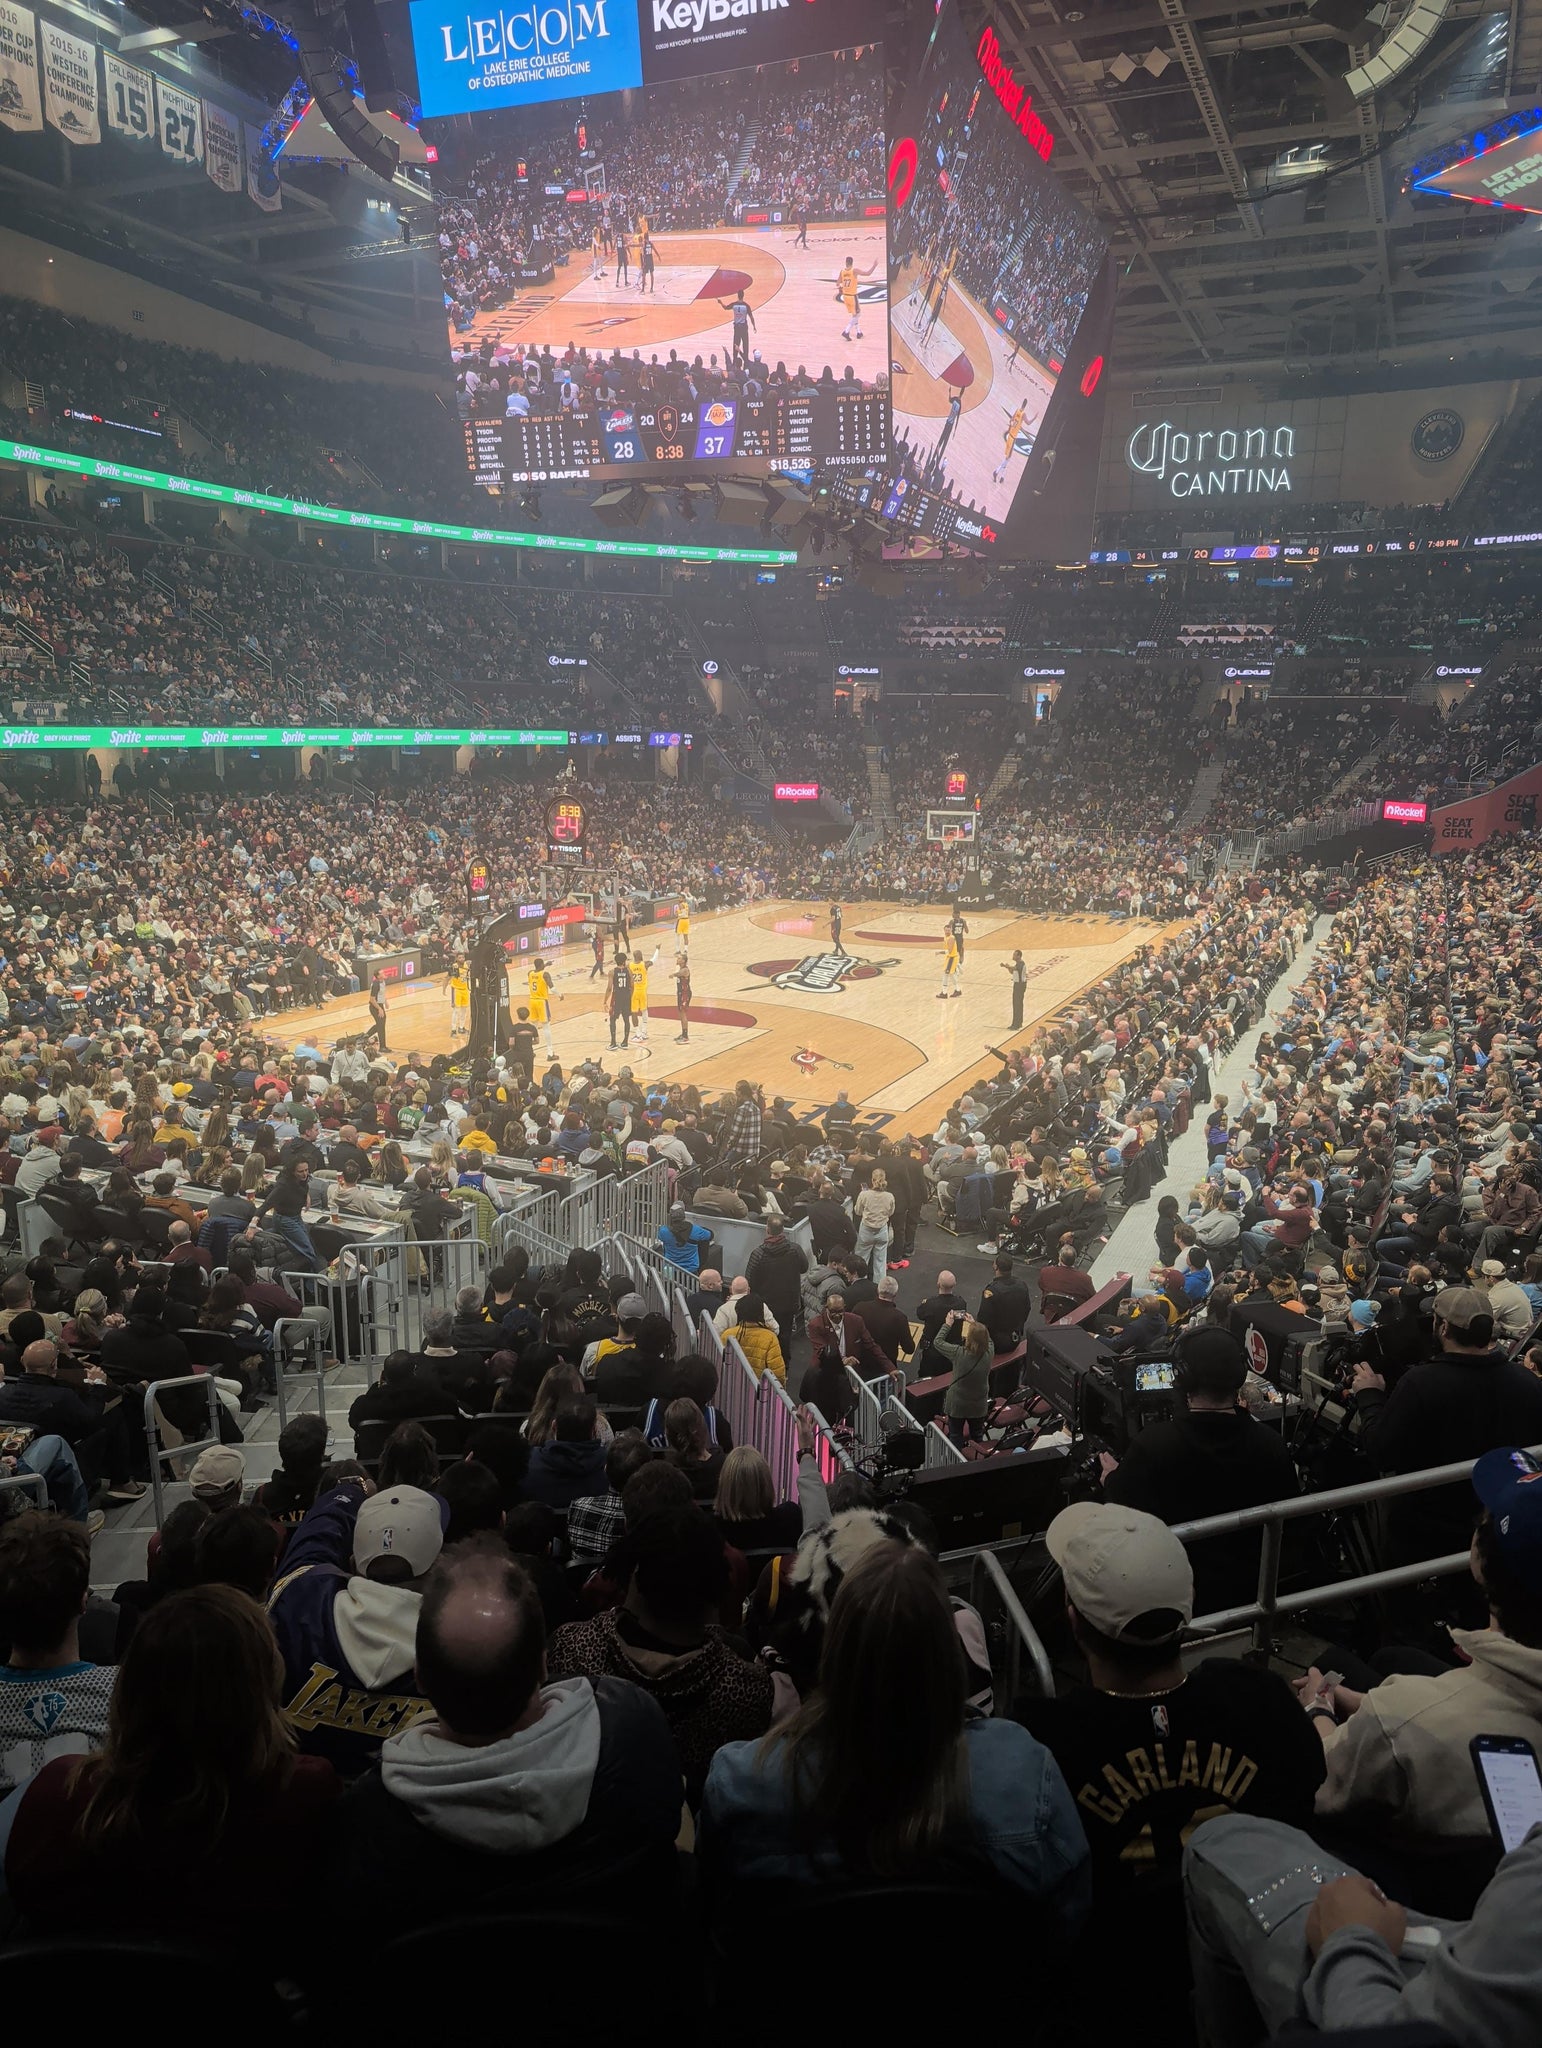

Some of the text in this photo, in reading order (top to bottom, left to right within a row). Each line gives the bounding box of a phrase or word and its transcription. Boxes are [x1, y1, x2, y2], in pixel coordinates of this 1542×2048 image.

[441, 0, 610, 62] LECOM
[715, 31, 735, 40] MEMBER
[15, 33, 34, 50] CUP
[49, 34, 88, 61] 2015-16
[51, 52, 89, 80] WESTERN
[484, 52, 571, 75] LAKE ERIE COLLEGE
[46, 65, 96, 98] CONFERENCE
[109, 62, 149, 89] CALLANDER
[468, 61, 591, 90] OF OSTEOPATHIC MEDICINE
[49, 81, 95, 112] CHAMPIONS
[983, 36, 1055, 162] Rocket Arena
[115, 82, 148, 135] 15
[165, 107, 196, 158] 27
[1481, 166, 1516, 188] LET
[746, 214, 768, 223] ESPN
[681, 412, 693, 423] 24
[753, 408, 759, 416] 0
[789, 408, 808, 416] AYTON
[475, 419, 503, 427] CAVALIERS
[640, 415, 654, 426] 2Q
[789, 417, 813, 425] VINCENT
[1421, 413, 1457, 429] CLEVELAND
[664, 423, 672, 431] -9
[477, 436, 502, 444] PROCTOR
[704, 437, 725, 455] 37
[13, 445, 41, 461] Sprite
[614, 441, 634, 458] 28
[656, 445, 684, 459] 8:38
[790, 445, 812, 453] DONCIC
[1126, 421, 1297, 480] Corona
[1420, 445, 1453, 458] MONSTERS
[770, 458, 811, 471] $18,526
[825, 454, 887, 466] CAVS5050.COM
[95, 463, 120, 477] Sprite
[475, 470, 500, 481] oswald
[549, 470, 590, 480] RAFFLE
[168, 477, 191, 492] Sprite
[1171, 467, 1291, 498] CANTINA
[233, 491, 254, 504] Sprite
[859, 487, 869, 502] 28
[292, 503, 311, 515] Sprite
[887, 500, 897, 514] 37
[350, 513, 371, 525] Sprite
[412, 522, 433, 533] Sprite
[954, 515, 983, 538] KeyBank
[472, 530, 494, 541] Sprite
[536, 536, 557, 547] Sprite
[1474, 537, 1496, 546] LET
[1496, 536, 1514, 545] EM
[595, 542, 617, 552] Sprite
[1333, 545, 1373, 554] FOULS 0
[1385, 541, 1415, 551] TOL 6
[1427, 539, 1459, 548] 7:49 PM
[656, 545, 677, 556] Sprite
[717, 550, 738, 560] Sprite
[1162, 551, 1178, 559] 8:38
[1194, 550, 1208, 559] 2Q
[1224, 549, 1236, 558] 37
[1284, 547, 1319, 555] FG% 48
[1106, 552, 1117, 562] 28
[33, 708, 49, 716] WTAM
[3, 730, 91, 747] Sprite THIRST
[109, 730, 141, 746] Sprite
[201, 730, 229, 746] Sprite
[281, 731, 306, 745] Sprite
[352, 731, 373, 744] Sprite
[414, 731, 433, 743] Sprite
[469, 732, 487, 743] Sprite
[519, 732, 536, 744] Sprite
[597, 734, 602, 743] 7
[615, 734, 641, 743] ASSISTS
[655, 734, 665, 744] 12
[785, 787, 816, 796] Rocket
[948, 780, 964, 793] 24
[735, 792, 770, 800] LECOM
[560, 805, 581, 817] 8:38
[1395, 805, 1424, 818] Rocket
[555, 816, 579, 838] 24
[1444, 817, 1474, 828] SEAT
[1441, 828, 1473, 839] GEEK
[558, 845, 582, 853] TISSOT
[473, 866, 486, 877] 8:38
[472, 876, 485, 890] 24
[545, 925, 563, 937] ROYAL
[541, 936, 564, 948] RUMBLE
[618, 977, 627, 988] 31
[632, 973, 643, 982] 23
[532, 982, 538, 991] 5
[572, 1300, 608, 1317] MITCHELL
[48, 1697, 58, 1712] 75
[284, 1661, 434, 1738] LAKER
[1078, 1740, 1259, 1825] GARLAND
